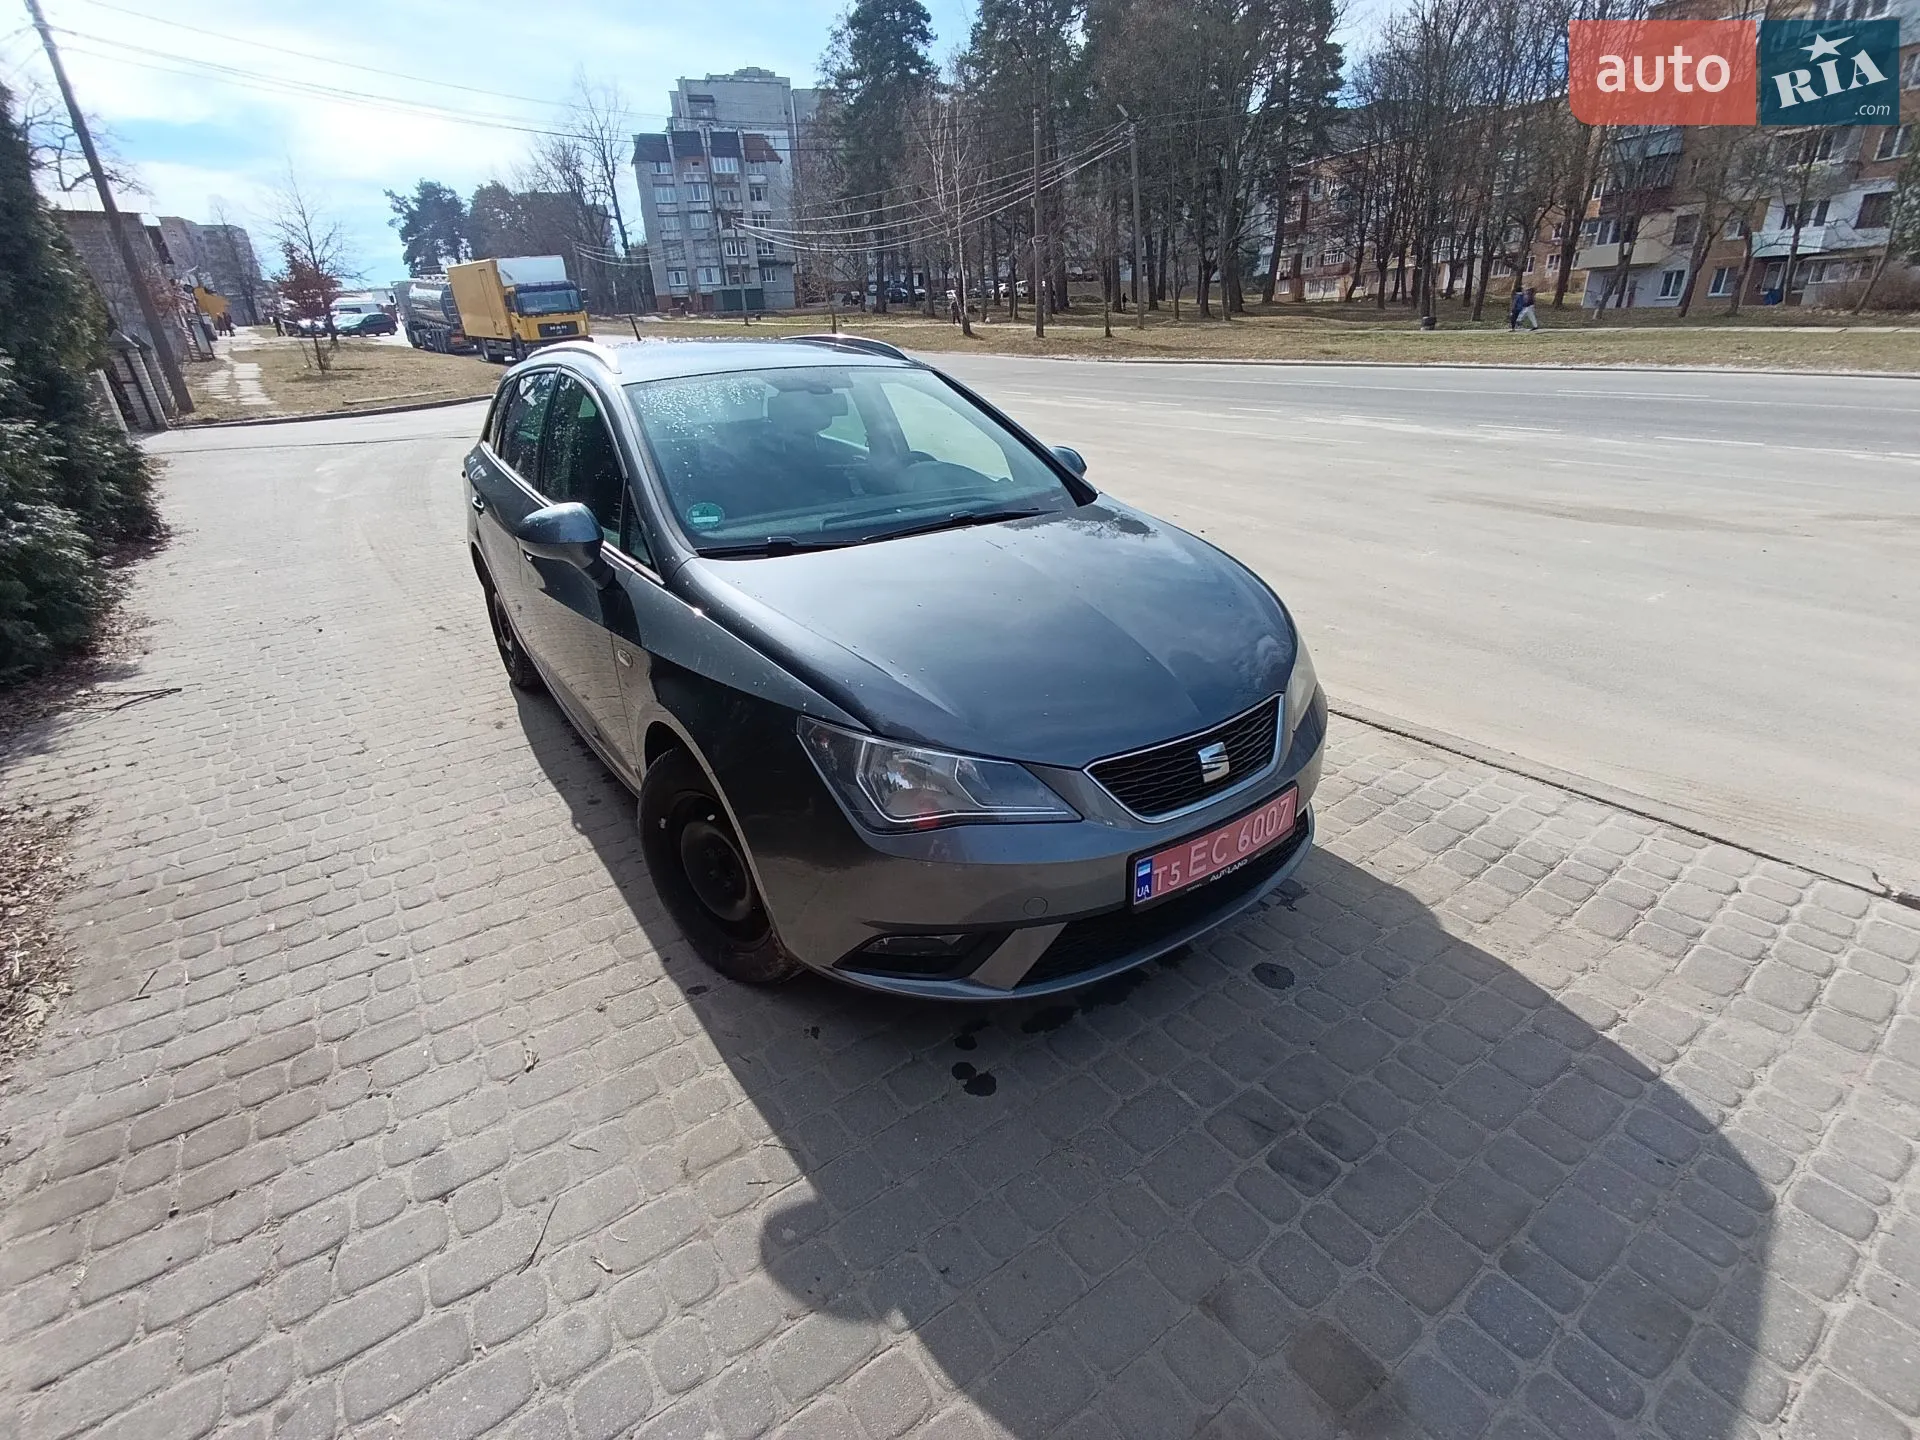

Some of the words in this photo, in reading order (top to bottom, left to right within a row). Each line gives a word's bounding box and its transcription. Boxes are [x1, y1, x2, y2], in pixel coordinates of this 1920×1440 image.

[1153, 860, 1181, 891] T5
[1188, 833, 1230, 877] EC
[1237, 797, 1291, 853] 6007
[1137, 884, 1150, 898] UA
